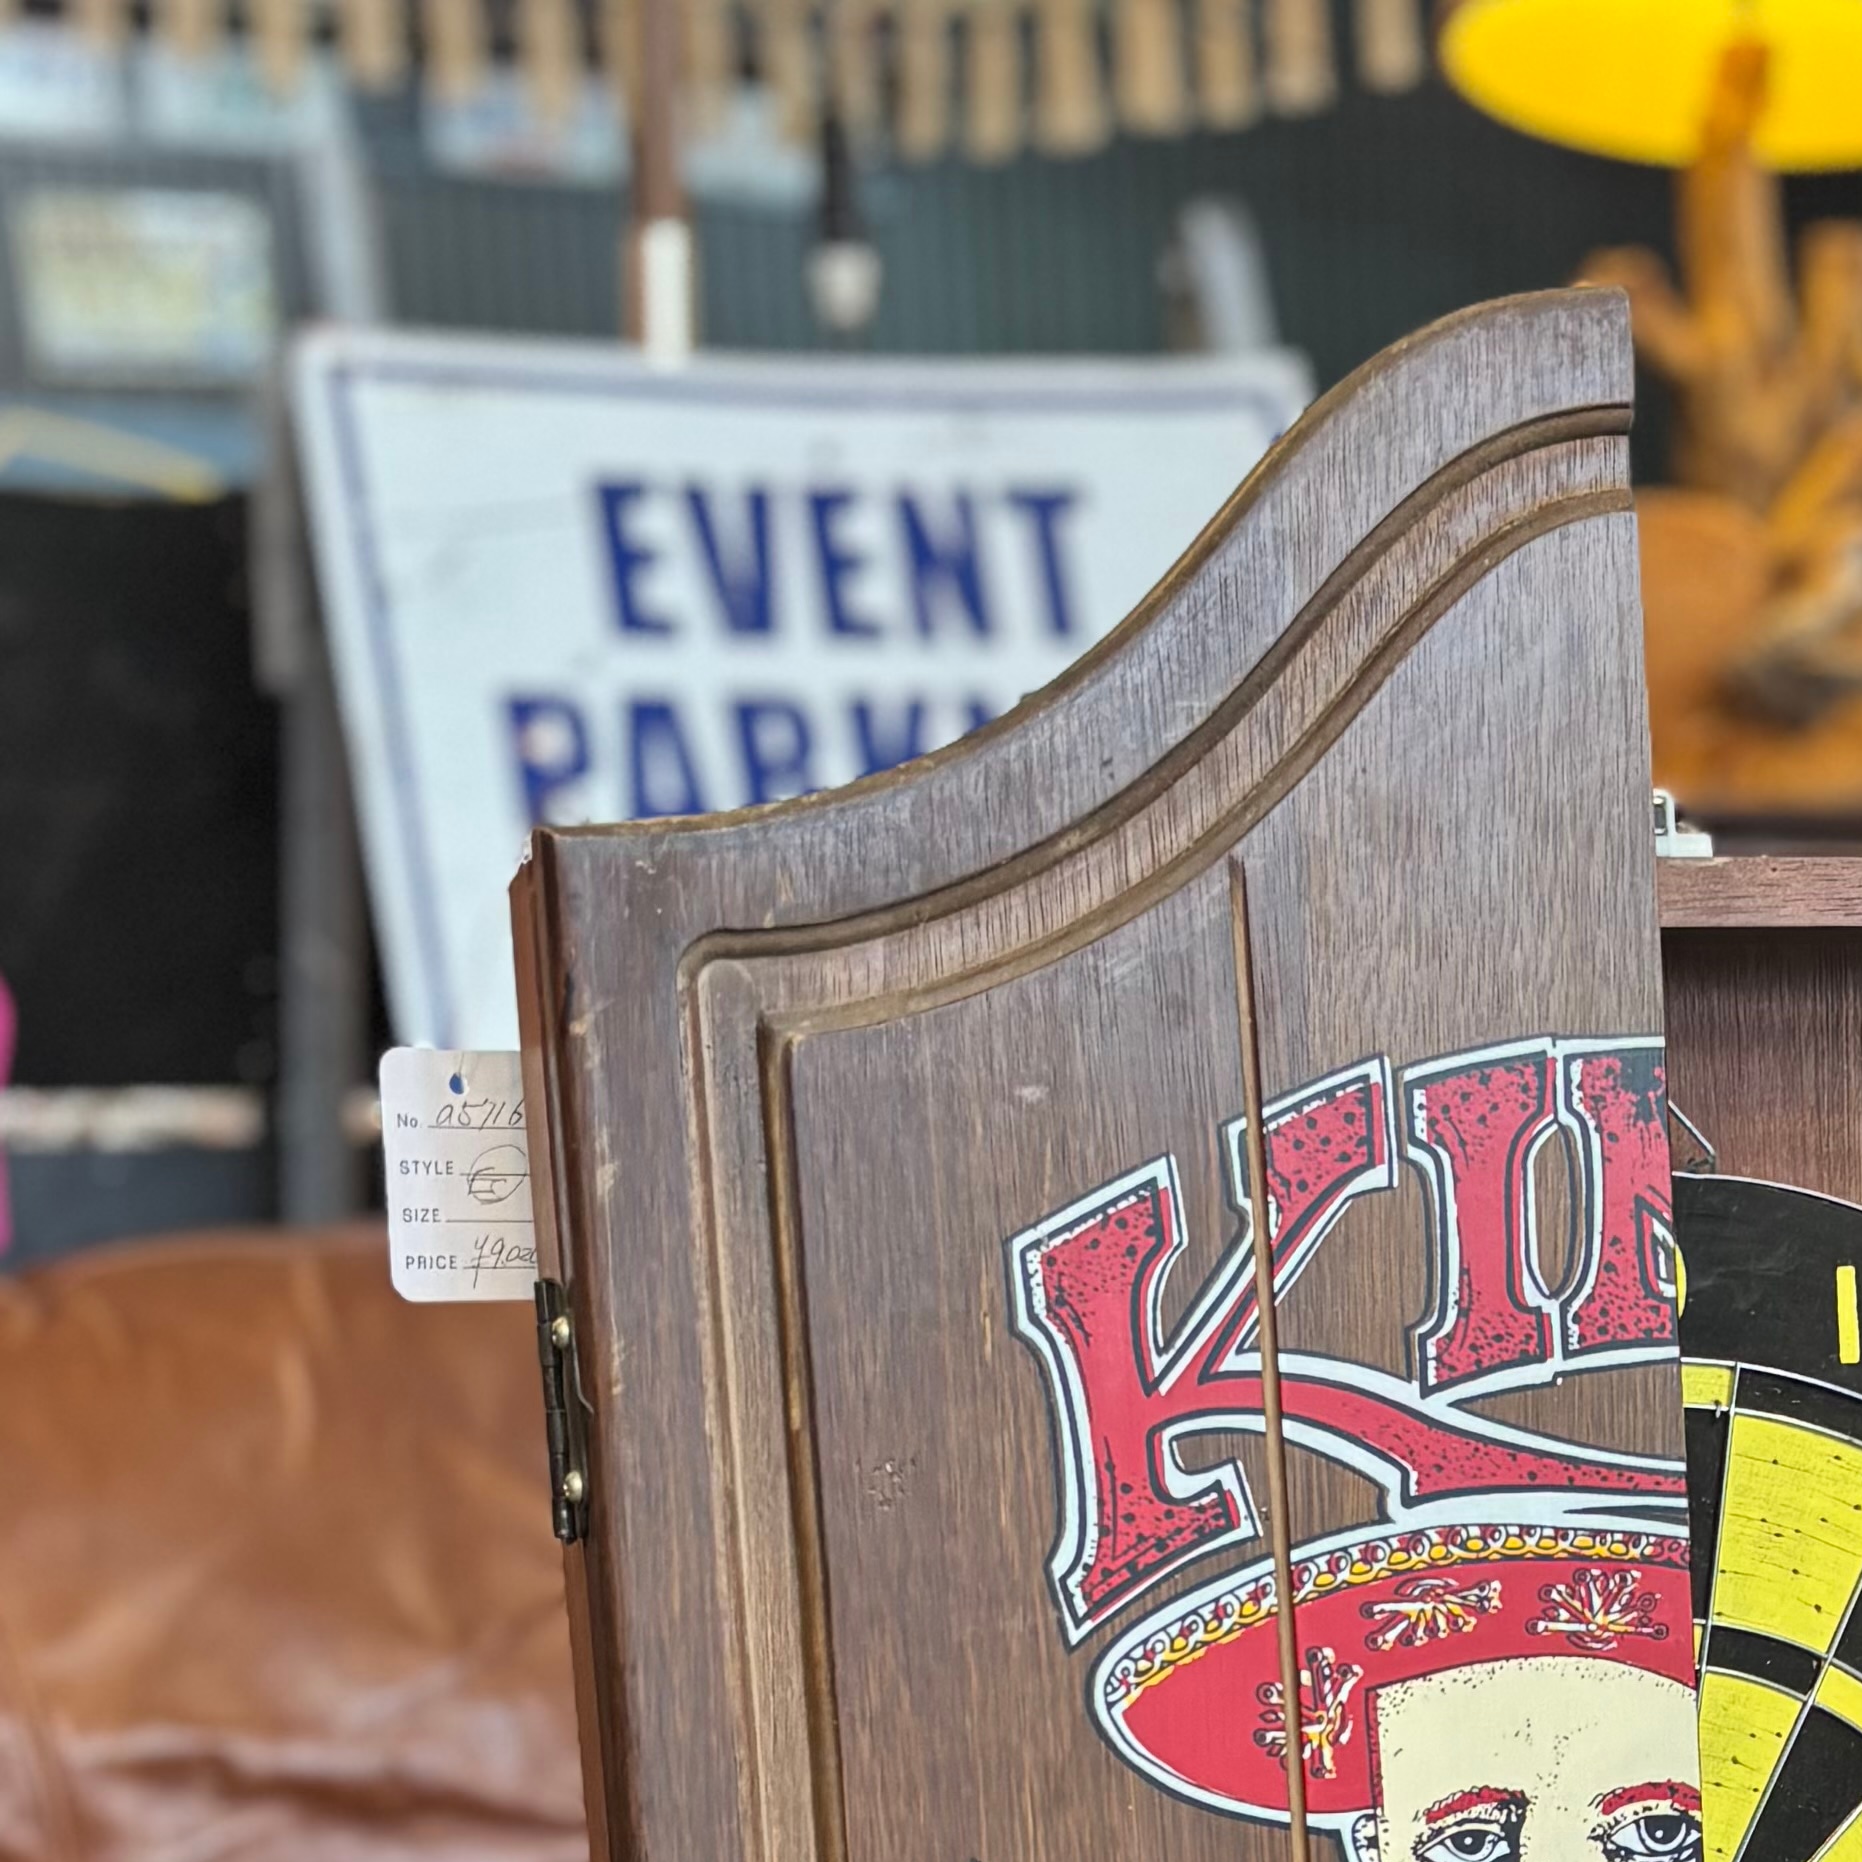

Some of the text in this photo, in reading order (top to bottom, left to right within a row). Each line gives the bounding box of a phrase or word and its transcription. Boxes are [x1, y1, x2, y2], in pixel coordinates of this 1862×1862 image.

[592, 478, 1086, 642] EVENT
[500, 690, 1002, 832] PAR
[399, 1160, 454, 1176] STYLE
[402, 1208, 442, 1223] SIZE
[405, 1255, 458, 1270] PRICE
[1836, 1265, 1861, 1364] 1
